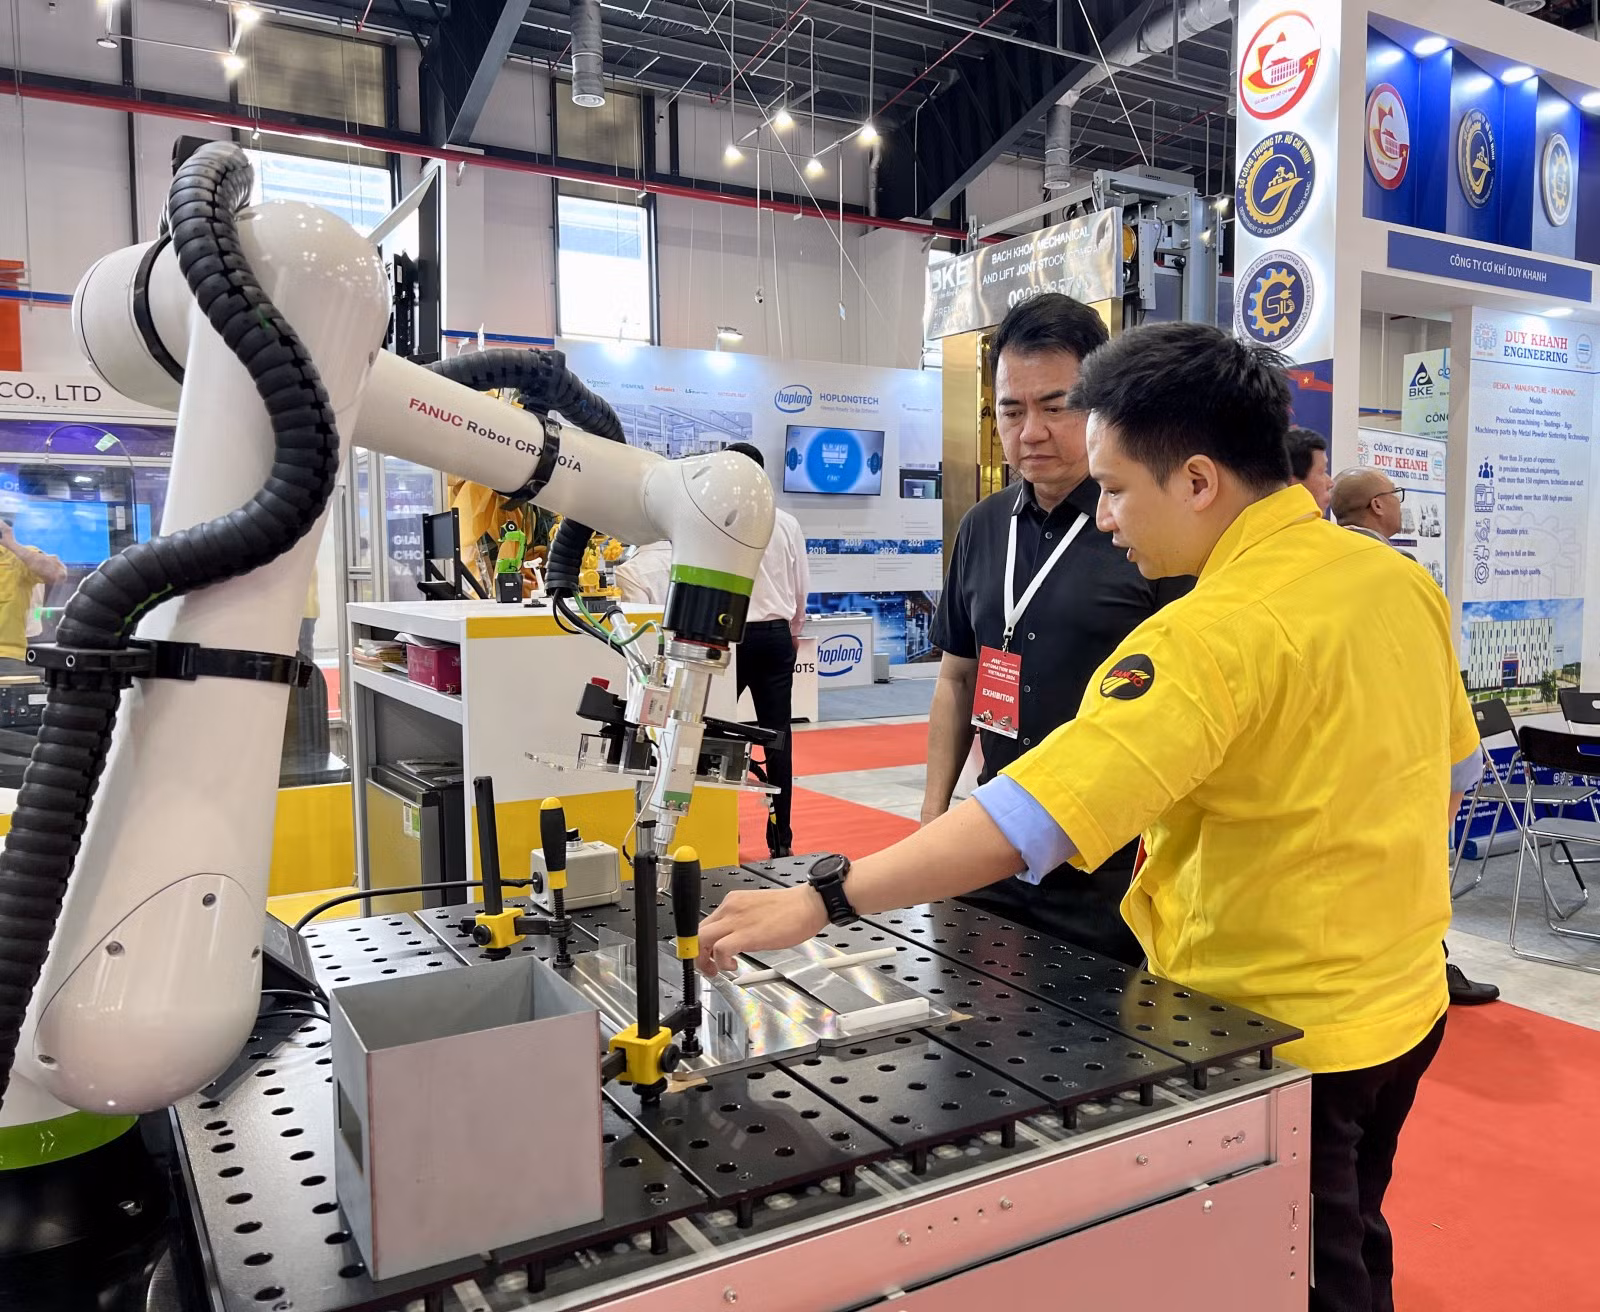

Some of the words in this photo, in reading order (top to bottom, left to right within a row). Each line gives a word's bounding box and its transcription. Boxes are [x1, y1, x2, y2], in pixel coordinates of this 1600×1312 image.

[1238, 204, 1257, 233] DEPARTMENT
[1262, 222, 1285, 234] INDUSTRY
[991, 248, 1012, 265] BACH
[1013, 242, 1034, 258] KHOA
[1037, 226, 1090, 251] MECHANICAL
[982, 271, 998, 286] AND
[999, 267, 1015, 281] LIFT
[1038, 253, 1066, 269] STOCK
[1449, 253, 1471, 269] CÔNG
[1472, 259, 1482, 271] TY
[1482, 260, 1493, 273] CƠ
[1493, 262, 1507, 275] KHÍ
[1507, 266, 1522, 278] DUY
[1522, 268, 1547, 283] KHANH
[1505, 330, 1528, 345] DUY
[1530, 333, 1568, 350] KHANH
[1503, 345, 1569, 364] ENGINEERING
[0, 381, 46, 403] CO.,
[55, 383, 102, 402] LTD
[1408, 386, 1433, 397] BKE
[1492, 381, 1511, 391] DESIGN
[1514, 384, 1547, 394] MANUFACTURE
[1551, 387, 1576, 397] MACHINING
[777, 390, 813, 407] hoplong
[819, 392, 879, 405] HOPLONGTECH
[1529, 396, 1543, 404] Molds
[1508, 405, 1535, 415] Customized
[1535, 408, 1561, 417] machineries
[408, 397, 464, 427] FANUC
[466, 420, 512, 446] Robot
[1495, 416, 1517, 425] Precision
[1517, 418, 1541, 428] machining
[1543, 420, 1561, 430] Toolings
[1475, 426, 1499, 436] Machinery
[1499, 428, 1511, 436] parts
[1511, 428, 1517, 437] by
[1518, 429, 1531, 437] Metal
[1532, 430, 1548, 438] Powder
[1567, 432, 1590, 443] Technology
[1373, 442, 1393, 453] CÔNG
[1394, 446, 1404, 455] TY
[1415, 449, 1428, 458] KHÍ
[1374, 454, 1393, 467] DUY
[1395, 457, 1428, 472] KHANH
[1496, 527, 1518, 535] Reasonable
[808, 547, 827, 555] 2018
[844, 539, 863, 547] 2019
[879, 547, 899, 555] 2020
[907, 539, 925, 547] 2021
[1494, 549, 1510, 558] Delivery
[1494, 568, 1511, 576] Products
[817, 643, 863, 666] hoplong
[794, 663, 815, 673] OTS
[982, 661, 1008, 673] AUTOMATION
[987, 669, 1006, 678] VIETNAM
[1111, 669, 1145, 687] FANUC
[982, 687, 1015, 704] EXHIBITOR
